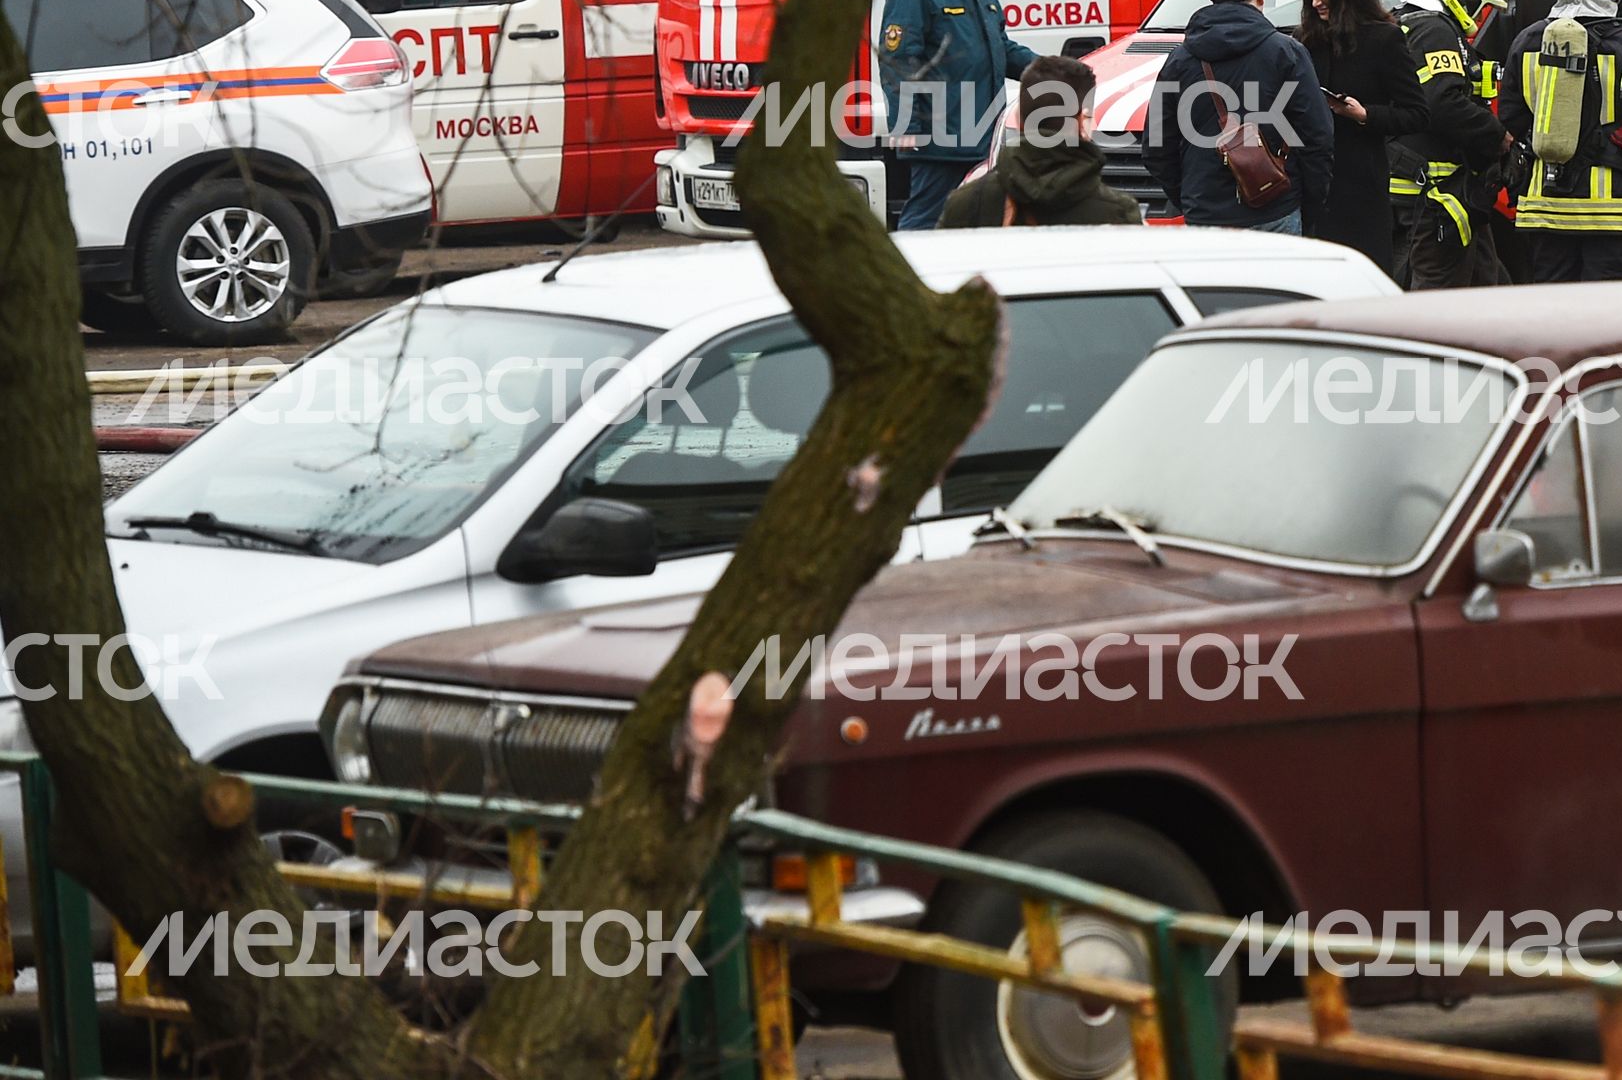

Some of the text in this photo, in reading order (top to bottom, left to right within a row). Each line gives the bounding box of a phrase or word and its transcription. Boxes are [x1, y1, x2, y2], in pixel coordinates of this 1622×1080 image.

[1002, 1, 1104, 28] ОСКВА
[391, 24, 501, 78] СПТ
[1430, 54, 1460, 71] 291
[691, 62, 750, 91] IVECO
[436, 114, 540, 140] МОСКВА
